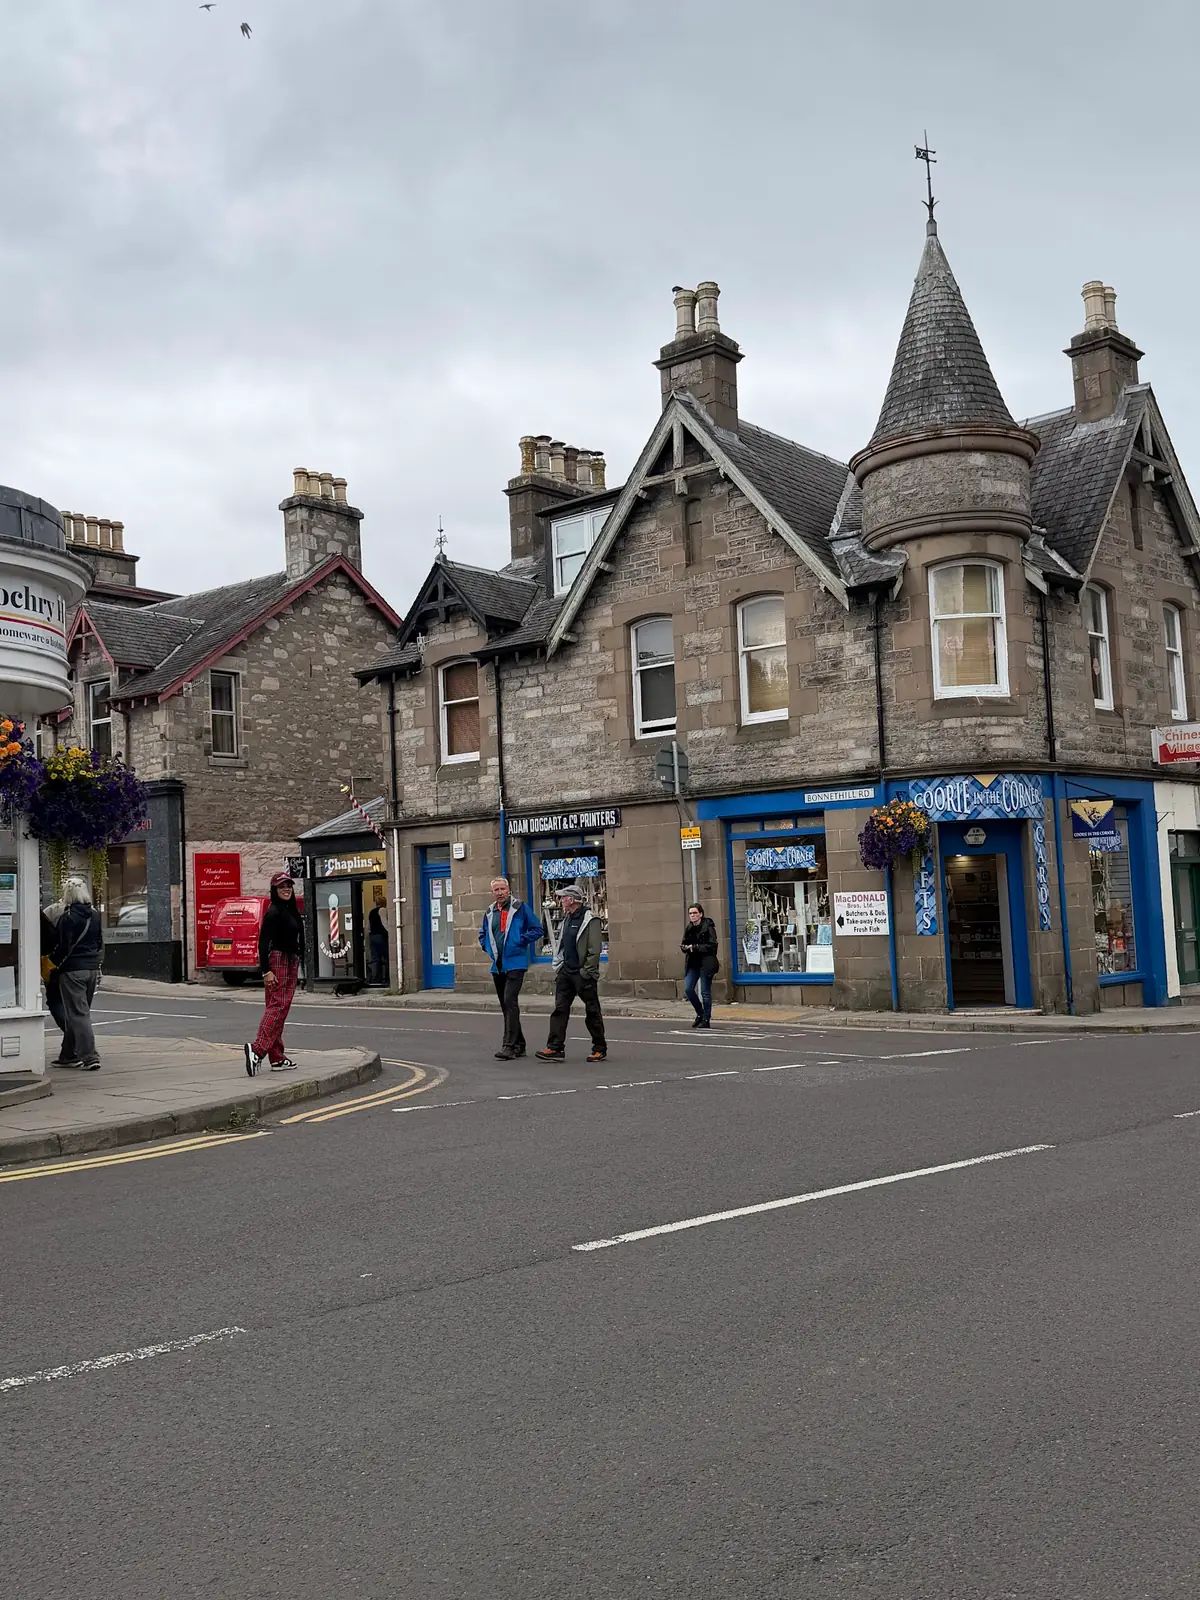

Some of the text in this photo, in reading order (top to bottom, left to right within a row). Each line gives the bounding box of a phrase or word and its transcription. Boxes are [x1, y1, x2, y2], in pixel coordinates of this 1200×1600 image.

[0, 627, 45, 644] omeware
[807, 789, 870, 802] BONNETHILL RD
[914, 779, 1041, 815] COORIE IN THE CORNER
[508, 820, 529, 834] ADAM
[529, 816, 562, 833] DOGGART
[562, 817, 569, 829] &
[580, 810, 616, 828] PRINTERS
[328, 856, 373, 872] Chaplins
[747, 851, 774, 868] COORIE
[787, 848, 814, 867] CORNER
[1036, 826, 1049, 924] CARDS
[836, 894, 886, 903] MacDONALD
[920, 856, 931, 930] IFTS
[846, 918, 873, 926] Take-away
